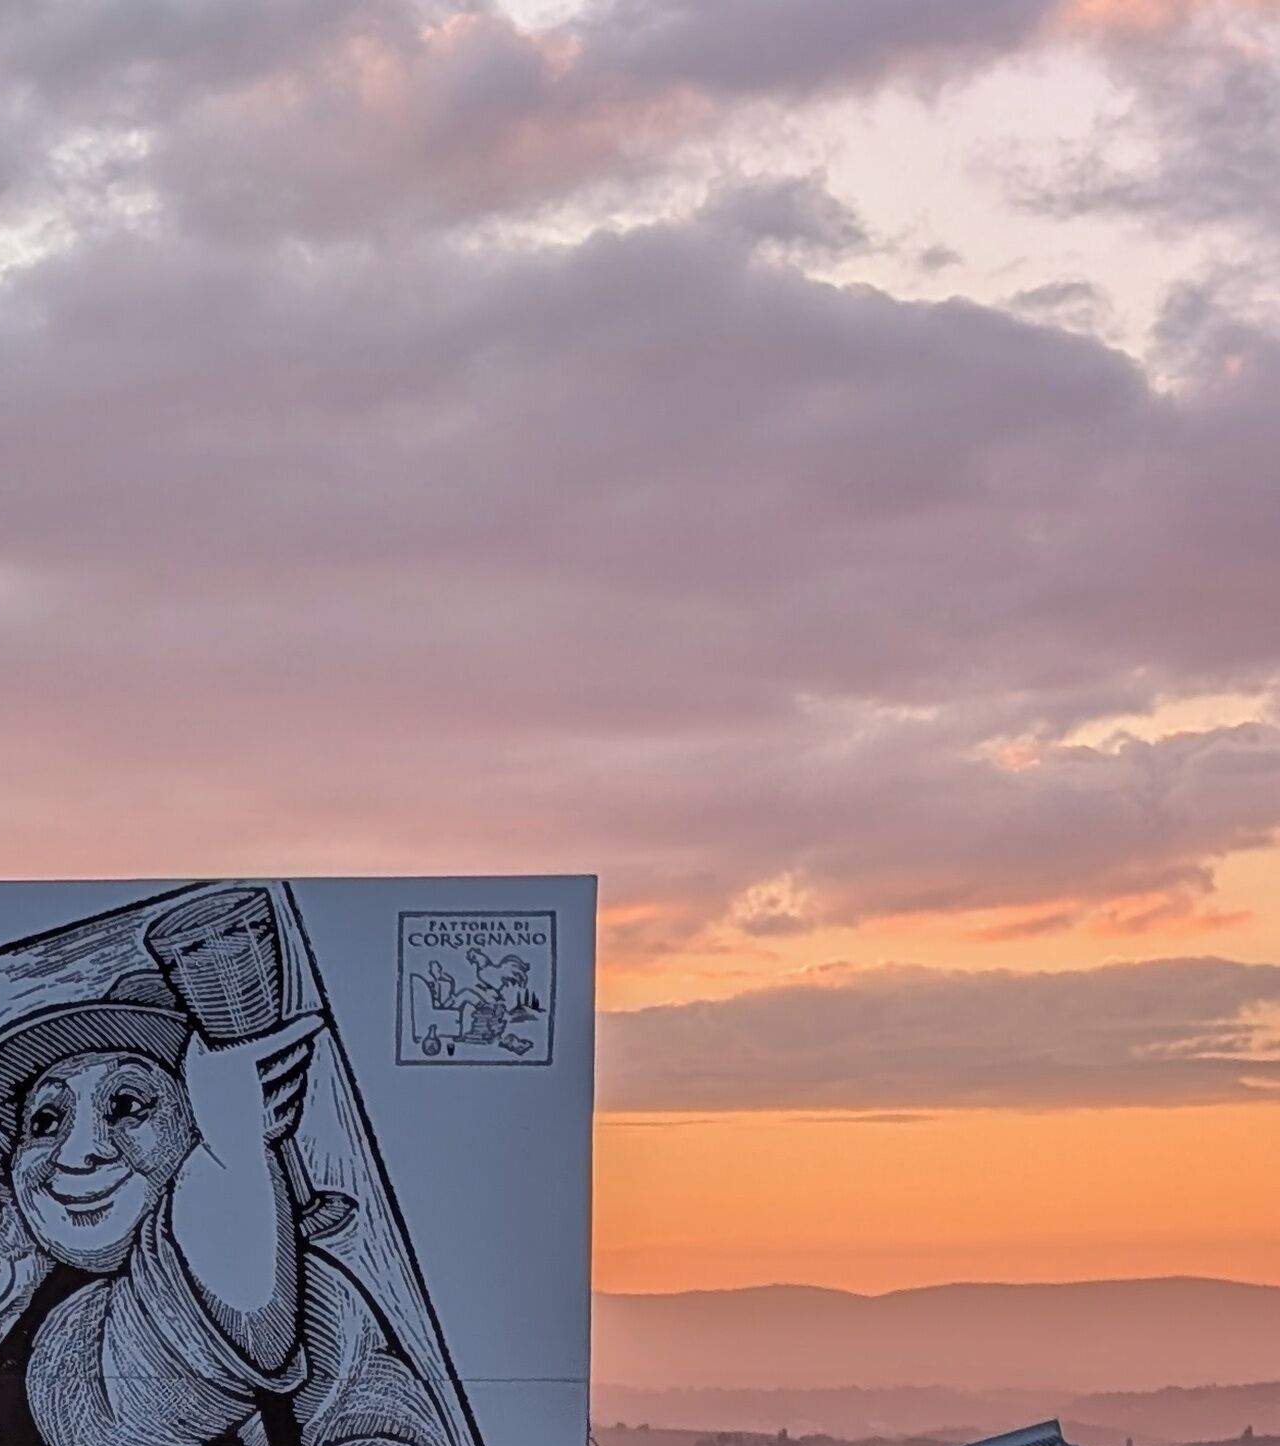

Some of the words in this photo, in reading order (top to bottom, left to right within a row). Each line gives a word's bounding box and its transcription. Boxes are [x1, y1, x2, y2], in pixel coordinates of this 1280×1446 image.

[429, 920, 505, 932] FATTORIA
[514, 920, 529, 931] DI
[408, 933, 547, 949] CORSIGNANO
